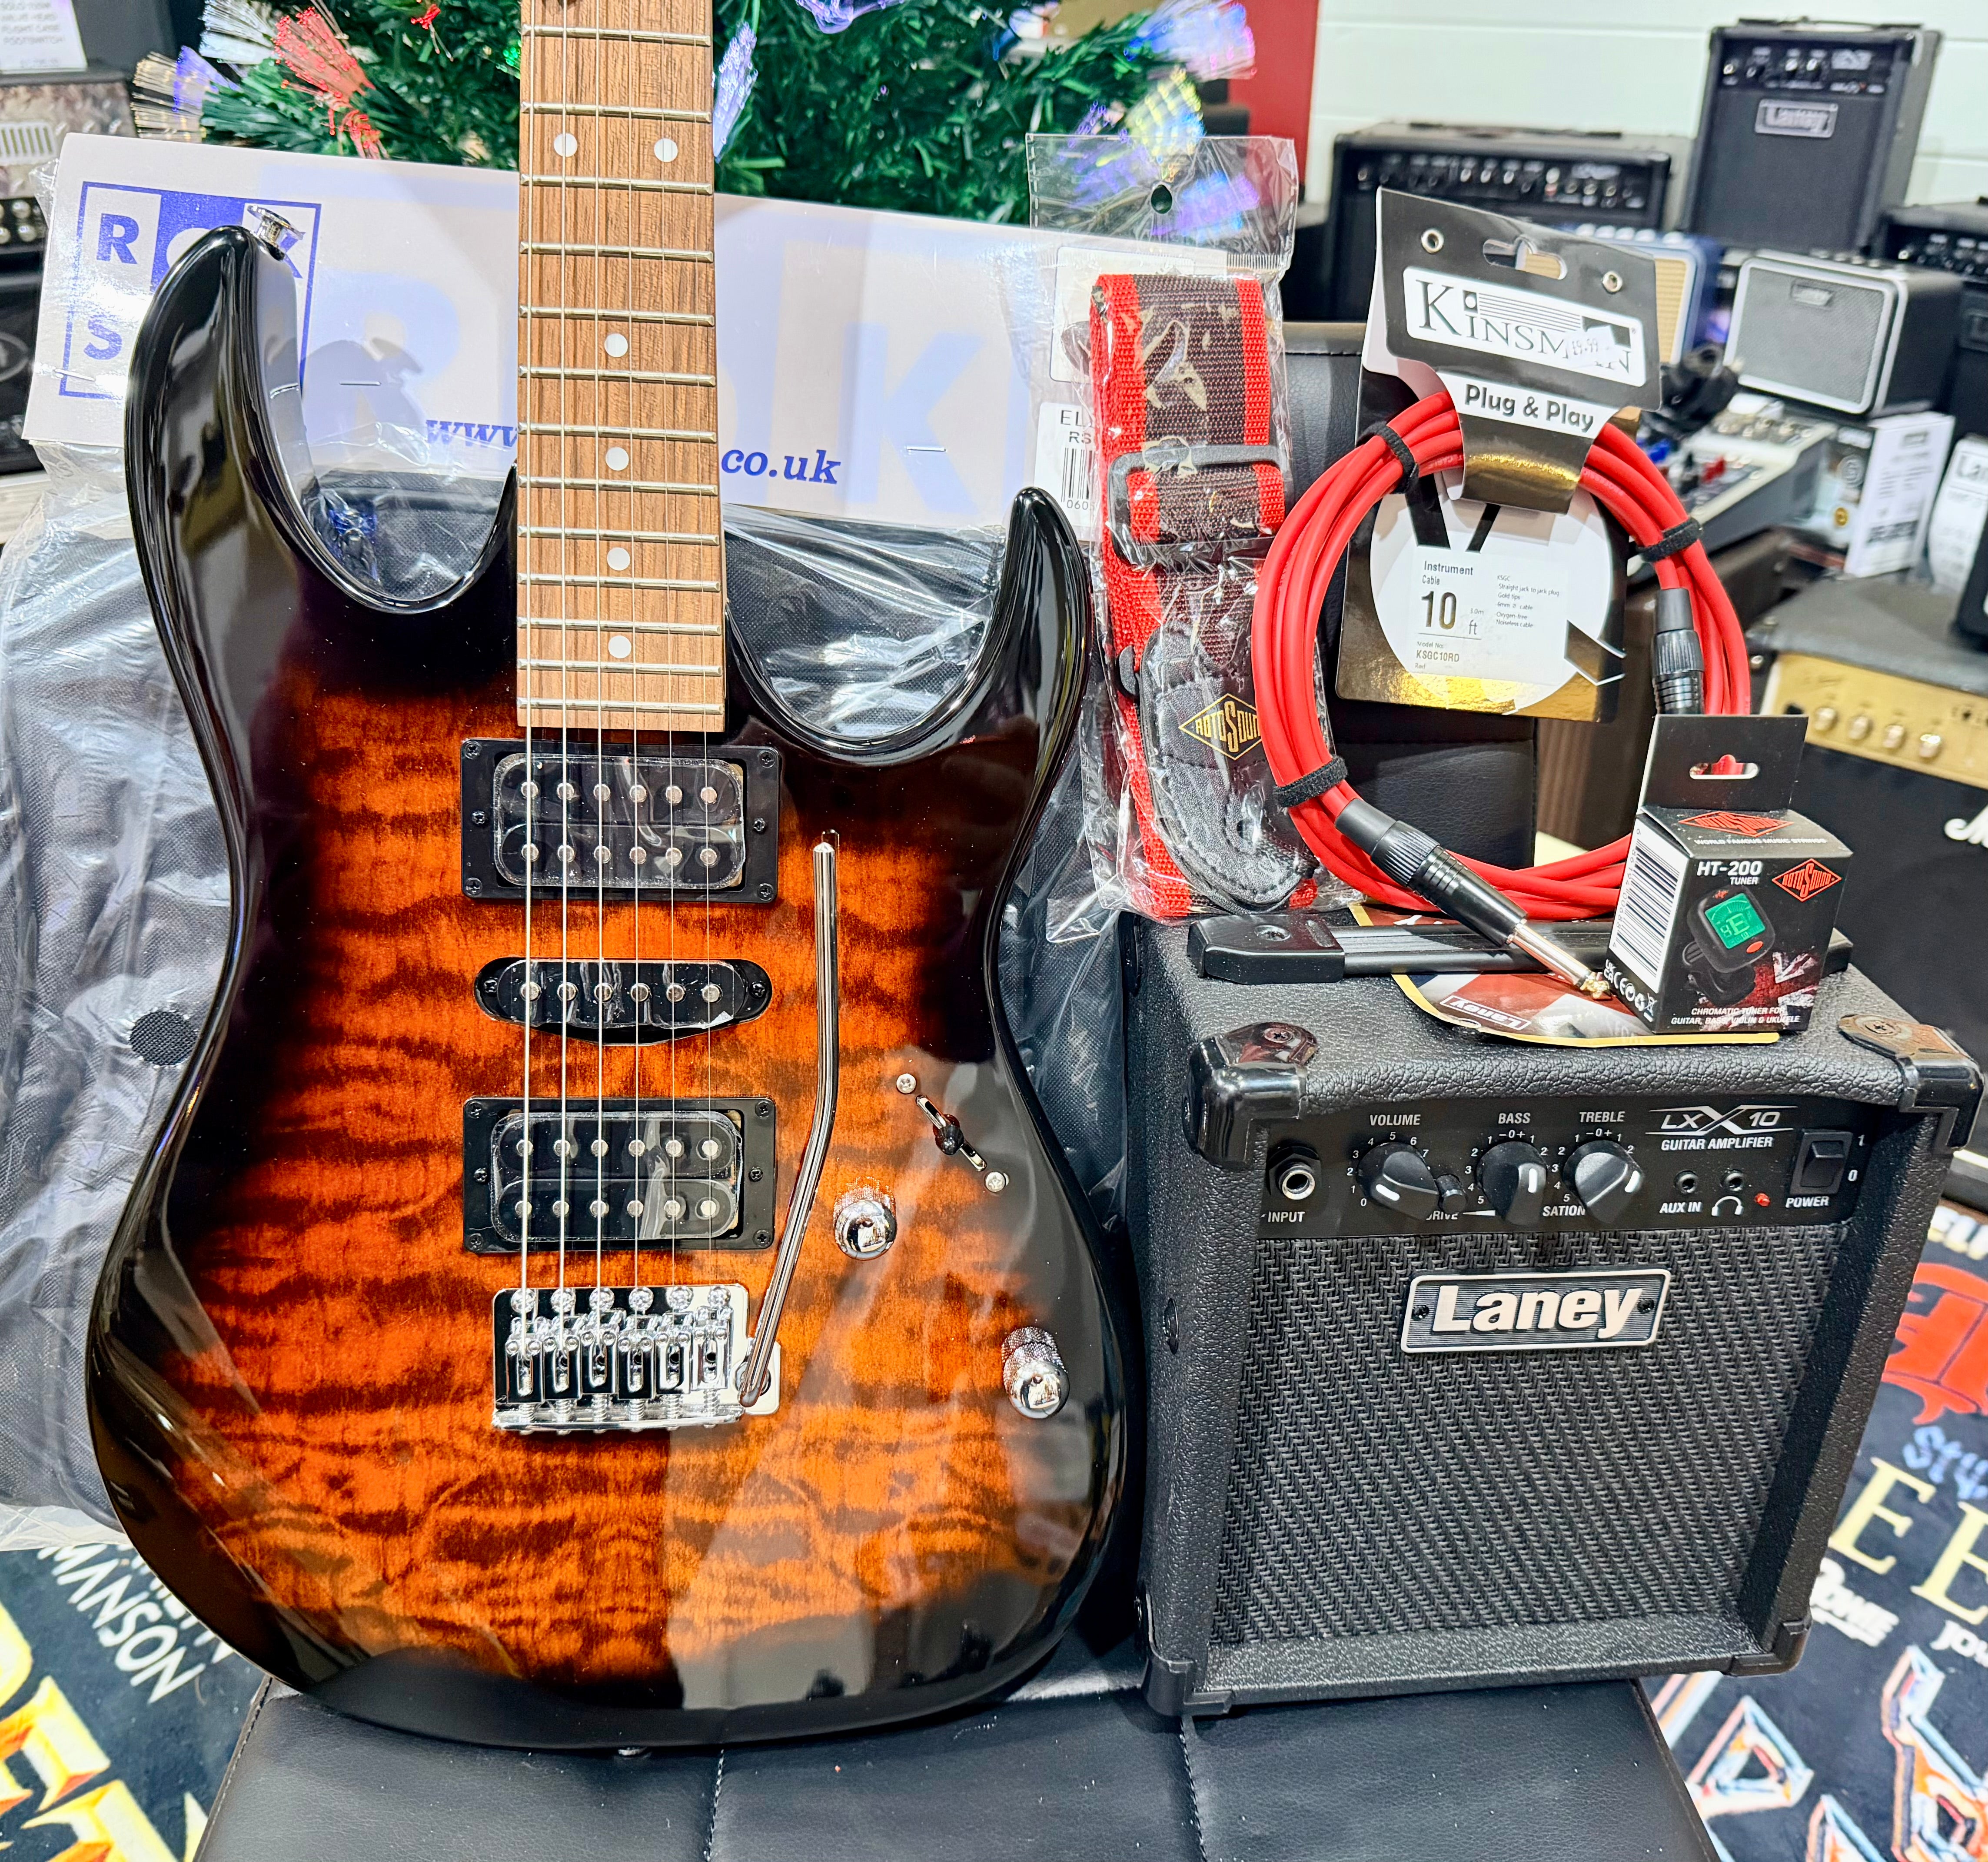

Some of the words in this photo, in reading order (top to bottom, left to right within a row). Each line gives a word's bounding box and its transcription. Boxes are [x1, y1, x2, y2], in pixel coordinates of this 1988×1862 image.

[1765, 107, 1829, 133] Laney
[1416, 279, 1632, 373] KINSMN
[1464, 384, 1516, 417] Plug
[1523, 396, 1539, 419] &
[1545, 399, 1594, 433] Play
[1424, 561, 1473, 575] Instrument
[1422, 575, 1440, 585] Cable
[1499, 583, 1518, 592] Straight
[1421, 591, 1456, 630] 10
[1469, 620, 1477, 635] ft
[1416, 650, 1459, 662] KSGC10RD
[1196, 701, 1261, 752] ROTOSOUN
[1697, 860, 1763, 876] HT-200
[1730, 876, 1759, 885] TUNER
[1726, 913, 1749, 935] E
[1452, 1001, 1522, 1027] Laney
[1370, 1114, 1421, 1126] VOLUME
[1498, 1112, 1531, 1124] BASS
[1579, 1111, 1626, 1122] TREBLE
[1410, 1137, 1417, 1145] 6
[1488, 1136, 1492, 1144] 1
[1530, 1135, 1535, 1144] 1
[1575, 1134, 1579, 1142] 1
[1617, 1133, 1622, 1141] 1
[1661, 1137, 1705, 1150] GUITAR
[1707, 1136, 1773, 1149] AMPLIFIER
[1353, 1150, 1359, 1158] 3
[1471, 1148, 1478, 1157] 2
[1540, 1147, 1548, 1156] 2
[1558, 1147, 1565, 1155] 2
[1627, 1145, 1634, 1154] 2
[1346, 1167, 1353, 1176] 2
[1465, 1166, 1472, 1174] 3
[1551, 1164, 1558, 1172] 3
[1848, 1170, 1858, 1181] 0
[1554, 1181, 1560, 1190] 4
[1360, 1198, 1367, 1207] 0
[1659, 1202, 1686, 1213] AUX
[1688, 1201, 1702, 1212] IN
[1785, 1196, 1829, 1208] POWER
[1268, 1211, 1305, 1222] INPUT
[1432, 1285, 1643, 1339] Laney
